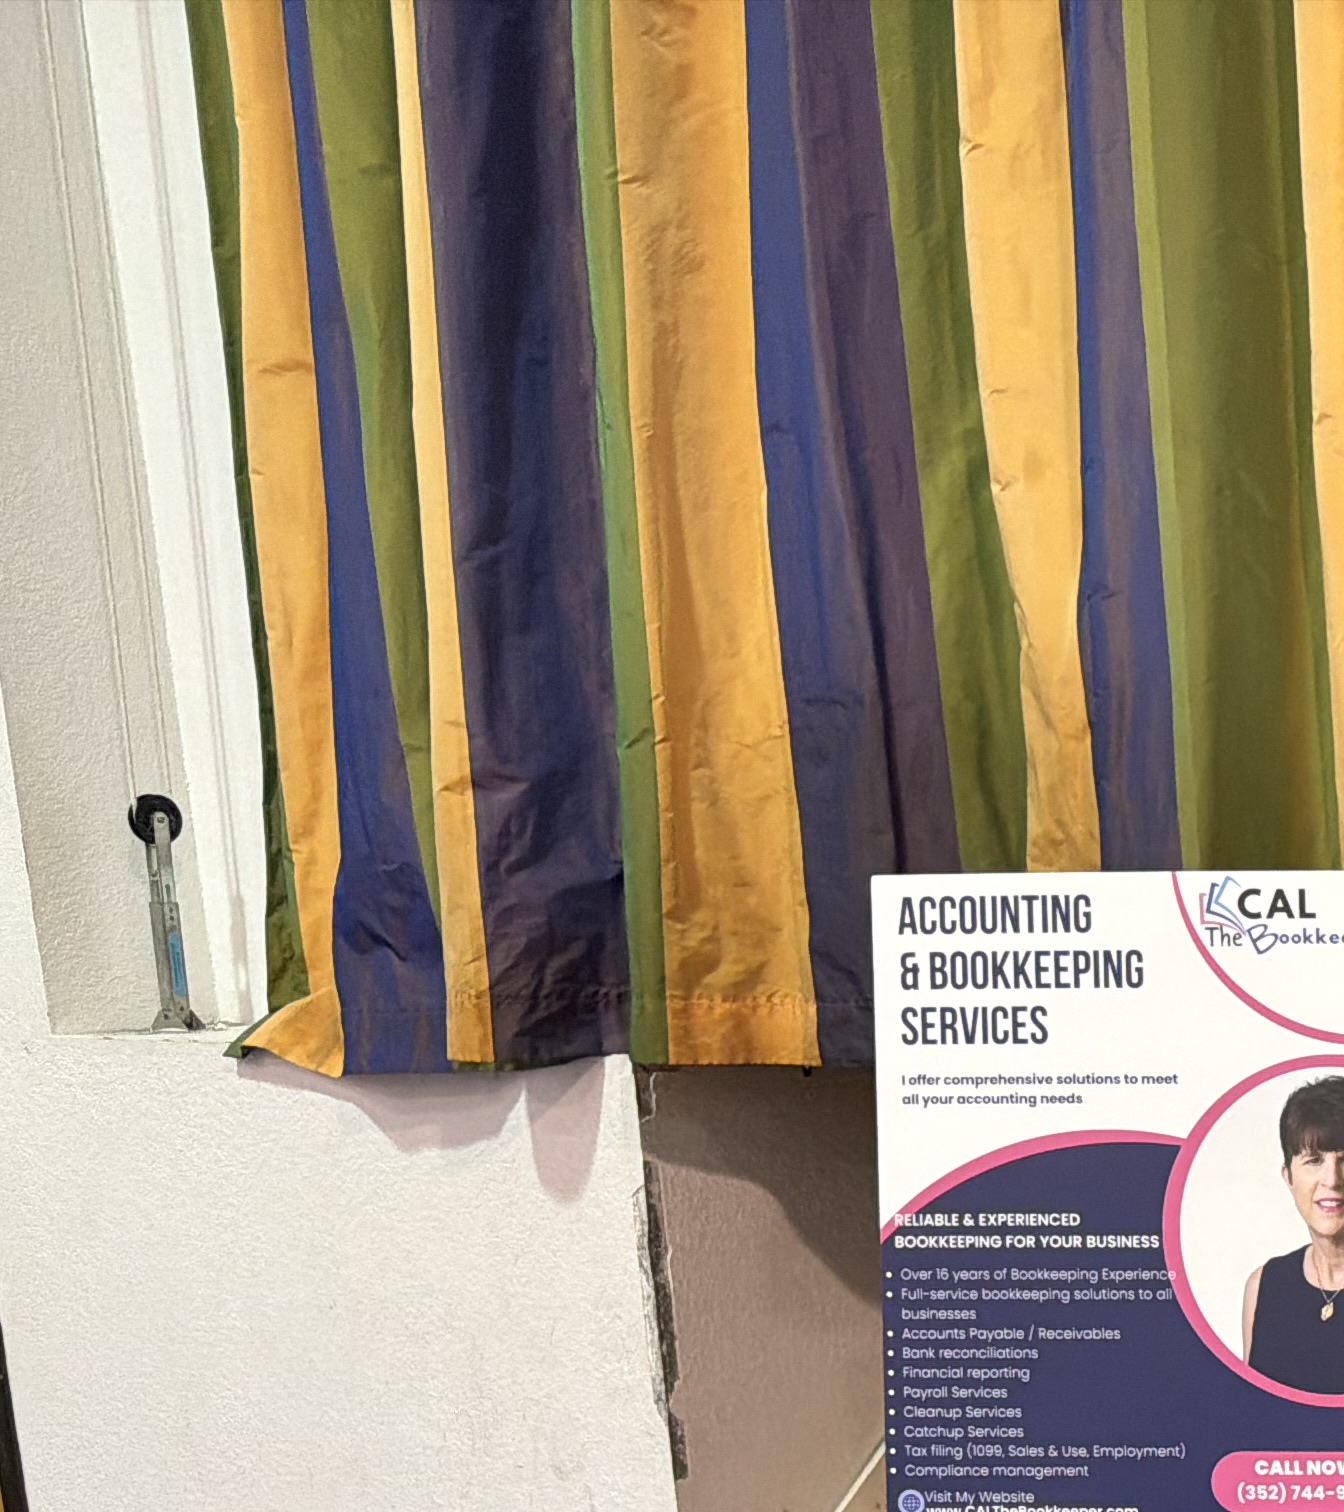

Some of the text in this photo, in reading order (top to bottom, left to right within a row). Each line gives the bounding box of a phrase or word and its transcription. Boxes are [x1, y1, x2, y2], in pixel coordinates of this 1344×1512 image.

[1237, 888, 1316, 919] CAL
[898, 894, 1091, 934] ACCOUNTING
[1205, 925, 1243, 947] The
[900, 950, 1144, 990] & BOOKKEEPING
[901, 1006, 1048, 1045] SERVICES
[901, 1073, 1178, 1088] I offer comprehensive solutions to meet
[902, 1092, 1083, 1108] all your accounting needs
[894, 1213, 1080, 1226] RELIABLE & EXPERIENCED
[894, 1235, 1160, 1248] BOOKKEEPING FOR YOUR BUSINESS
[900, 1268, 1177, 1284] Over 16 years of Bookkeeping Experience
[902, 1287, 1173, 1303] Full-service bookkeeping solutions to all
[902, 1307, 977, 1320] businesses
[902, 1324, 1121, 1343] Accounts Payable / Receivables
[902, 1347, 1039, 1359] Bank reconciliations
[903, 1366, 1030, 1382] Financial reporting
[903, 1386, 1007, 1401] Payroll Services
[903, 1406, 1022, 1421] Cleanup Services
[903, 1425, 1024, 1441] Catchup Services
[905, 1443, 1187, 1460] Tax filing (1099, Sales & Use, Employment)
[905, 1464, 1089, 1480] Compliance management
[1254, 1460, 1303, 1476] CALL
[924, 1491, 1035, 1506] Visit My Website
[1237, 1482, 1287, 1504] (352)
